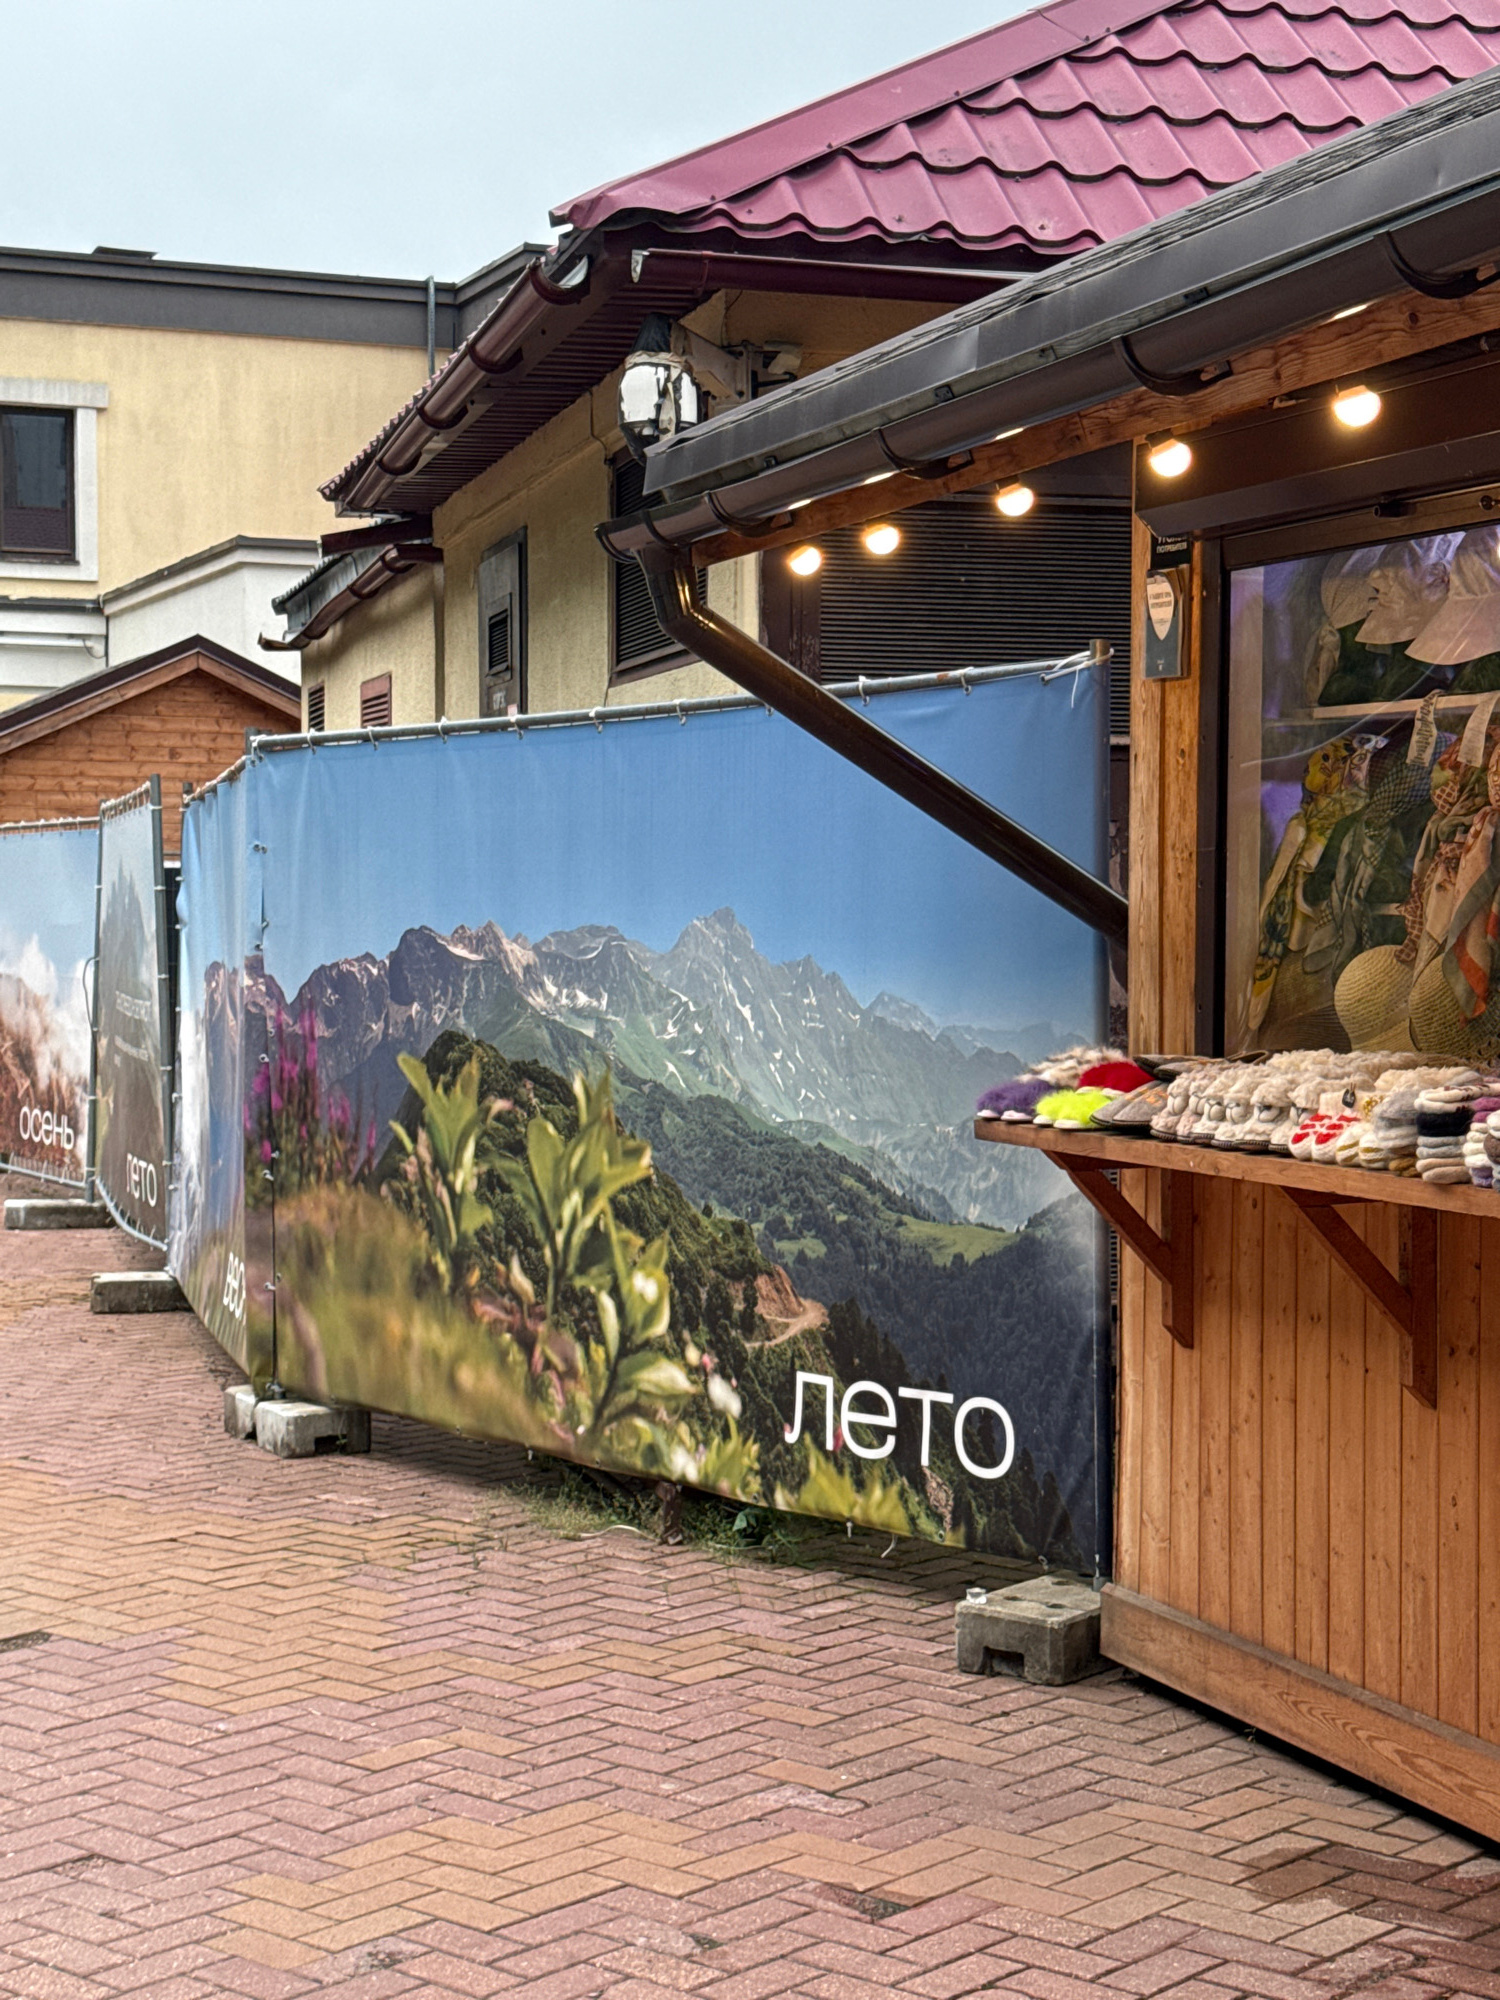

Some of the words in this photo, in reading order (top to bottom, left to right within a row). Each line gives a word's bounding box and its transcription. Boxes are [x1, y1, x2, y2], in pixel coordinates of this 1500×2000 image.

[19, 1105, 75, 1151] осень
[126, 1152, 158, 1208] лето
[222, 1251, 247, 1323] вес
[784, 1370, 1015, 1480] лето
